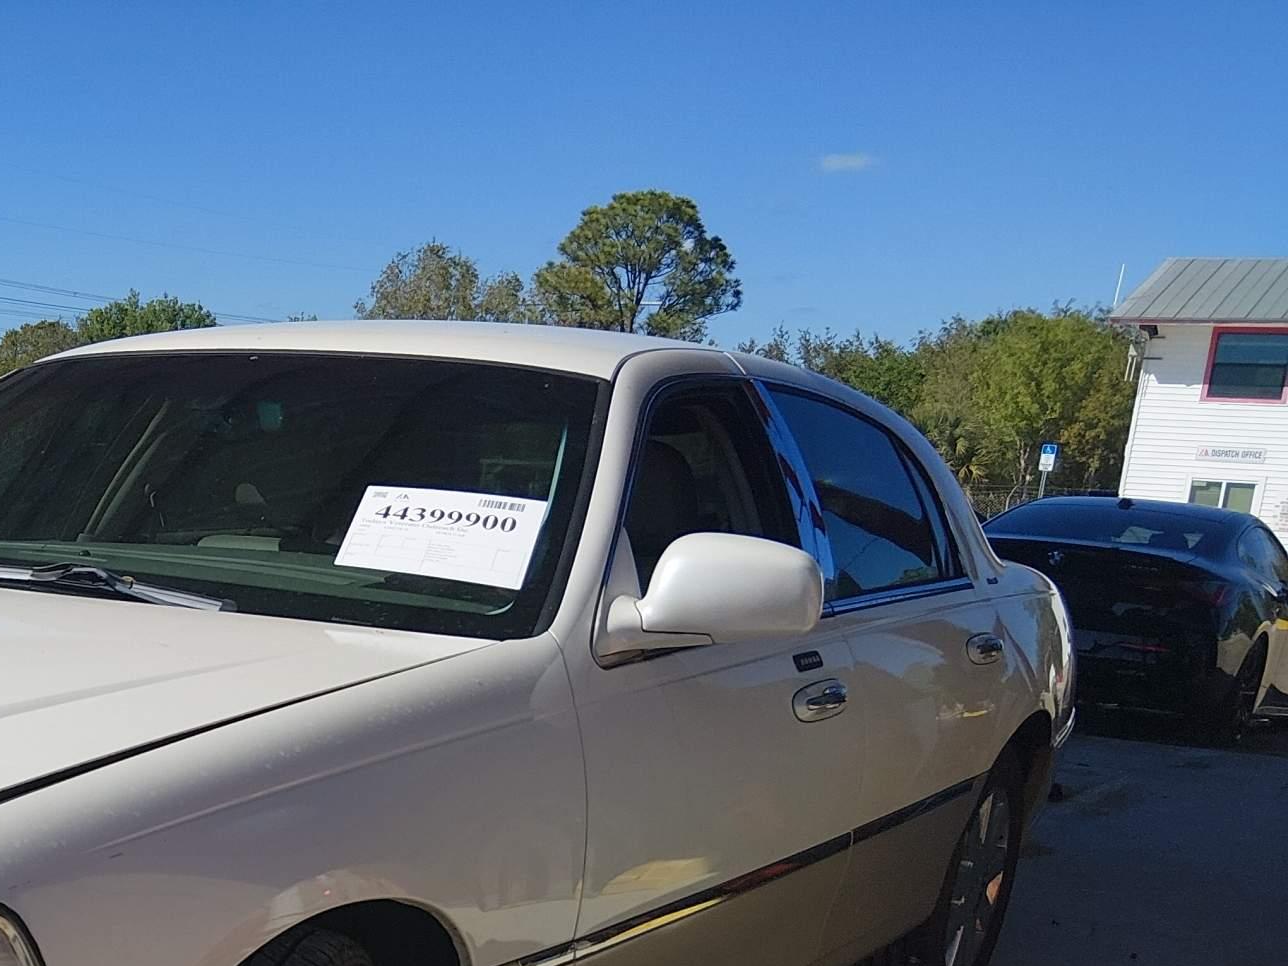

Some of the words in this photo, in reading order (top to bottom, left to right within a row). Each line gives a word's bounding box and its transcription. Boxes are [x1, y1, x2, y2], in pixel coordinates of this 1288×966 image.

[1211, 449, 1240, 458] DISPATCH
[1241, 450, 1263, 459] OFFICE
[374, 504, 517, 533] 44399900
